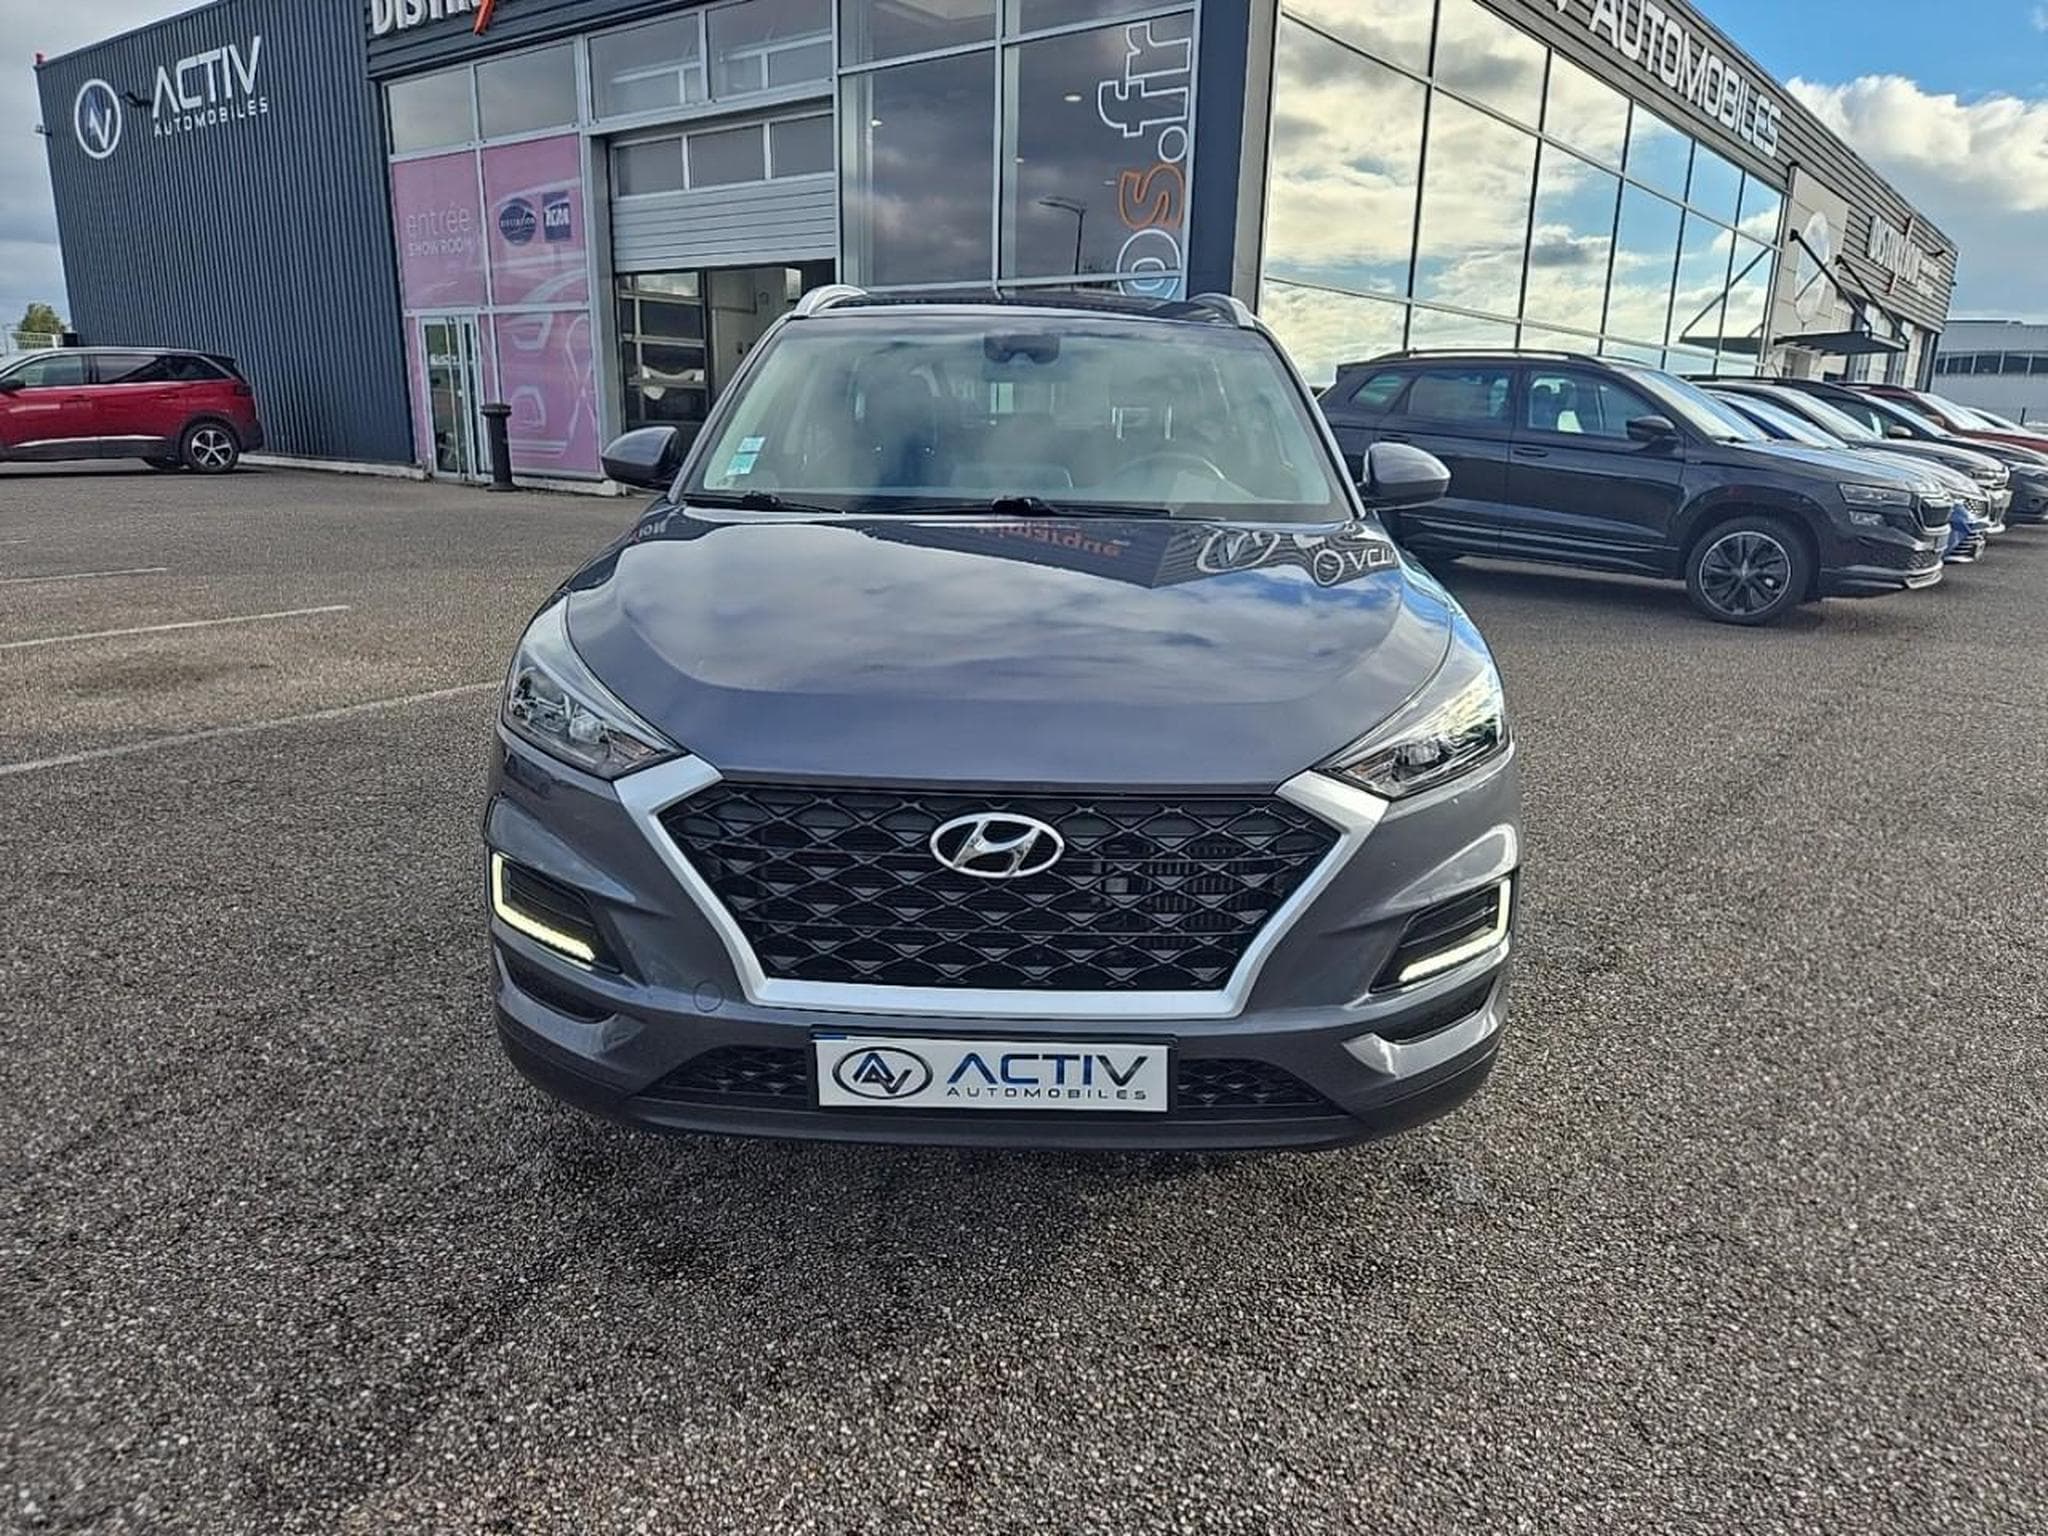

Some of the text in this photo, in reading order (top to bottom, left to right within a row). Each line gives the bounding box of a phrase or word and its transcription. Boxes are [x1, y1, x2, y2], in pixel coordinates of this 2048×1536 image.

[152, 36, 261, 118] ACTIV
[1589, 0, 1782, 158] AUTOMOBILES
[154, 97, 269, 137] AUTOMOBILES
[947, 1052, 1148, 1087] ACTIV
[946, 1086, 1146, 1100] AUTOMOBILES
